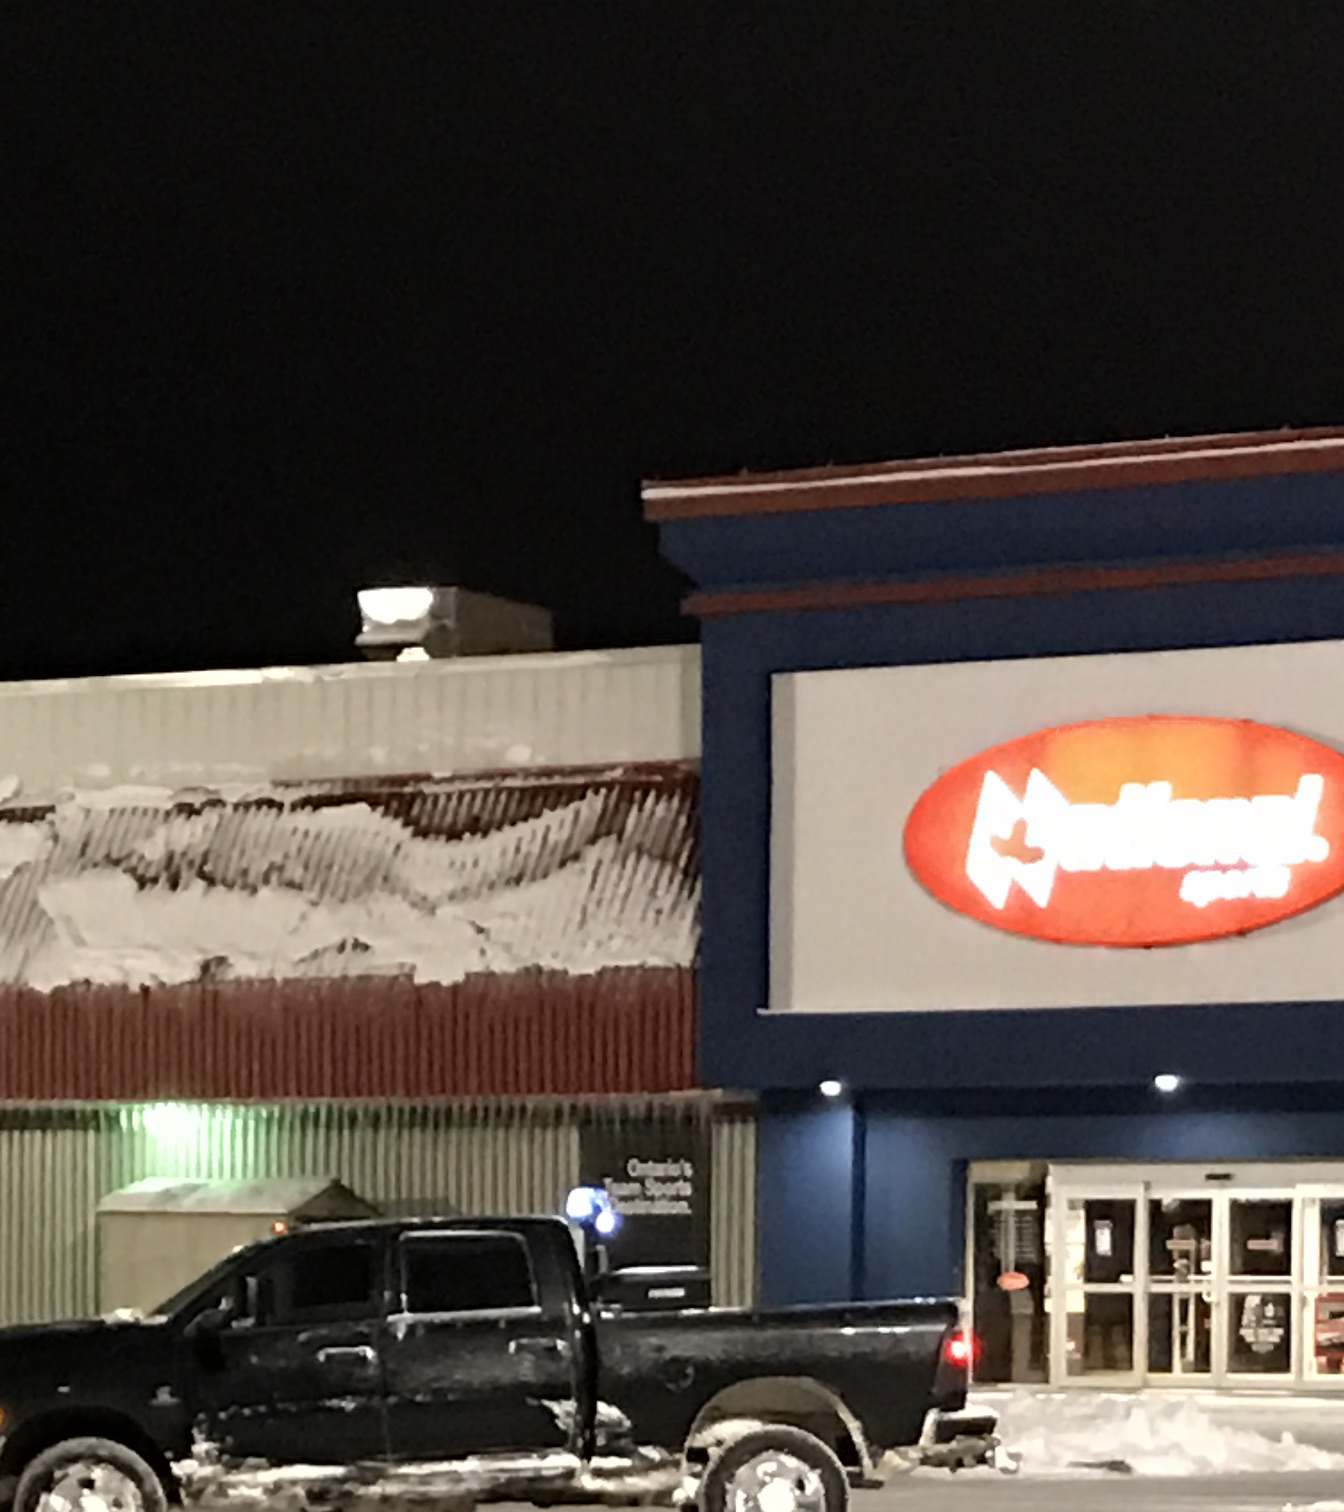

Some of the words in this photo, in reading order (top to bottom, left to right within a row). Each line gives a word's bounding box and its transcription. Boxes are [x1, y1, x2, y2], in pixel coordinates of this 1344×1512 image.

[628, 1159, 692, 1176] Ontario's
[603, 1177, 642, 1196] Team
[645, 1177, 692, 1197] Sports
